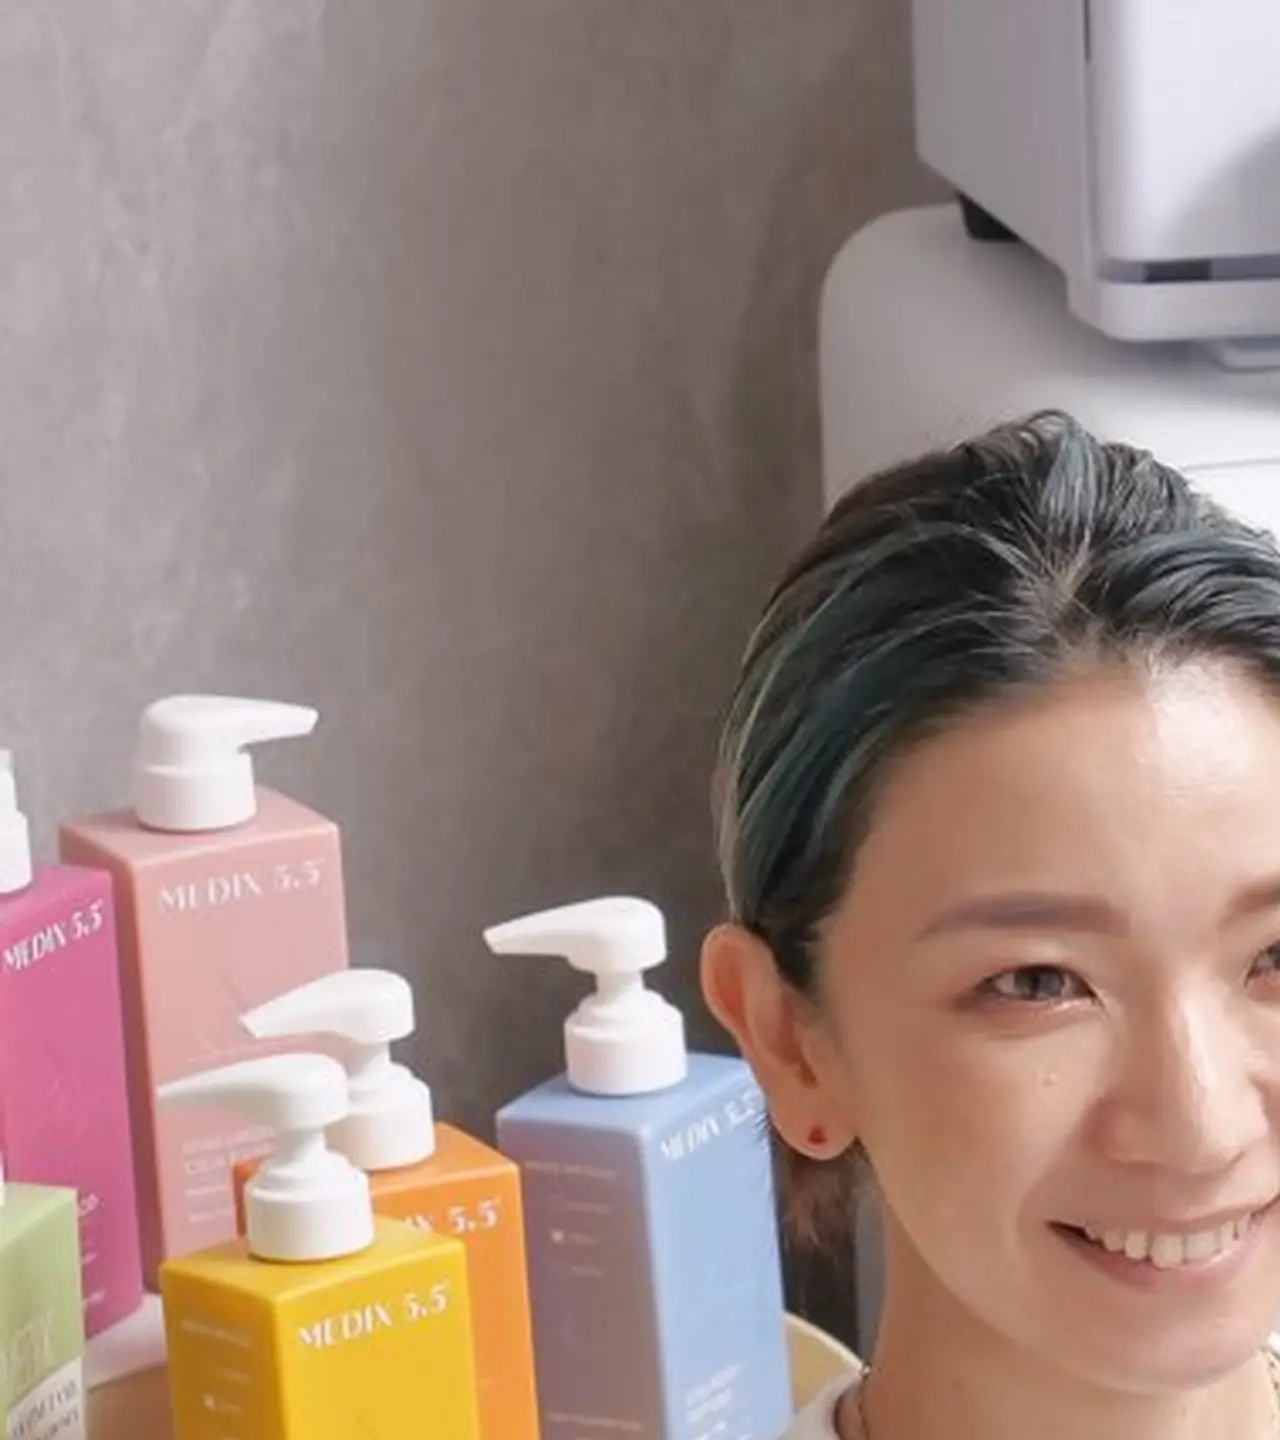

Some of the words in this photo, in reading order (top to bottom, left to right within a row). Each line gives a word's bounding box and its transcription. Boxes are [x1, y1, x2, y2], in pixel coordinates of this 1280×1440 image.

[158, 870, 262, 911] MEDIX
[3, 921, 66, 974] MEDIX
[299, 1302, 393, 1349] MEDIX
